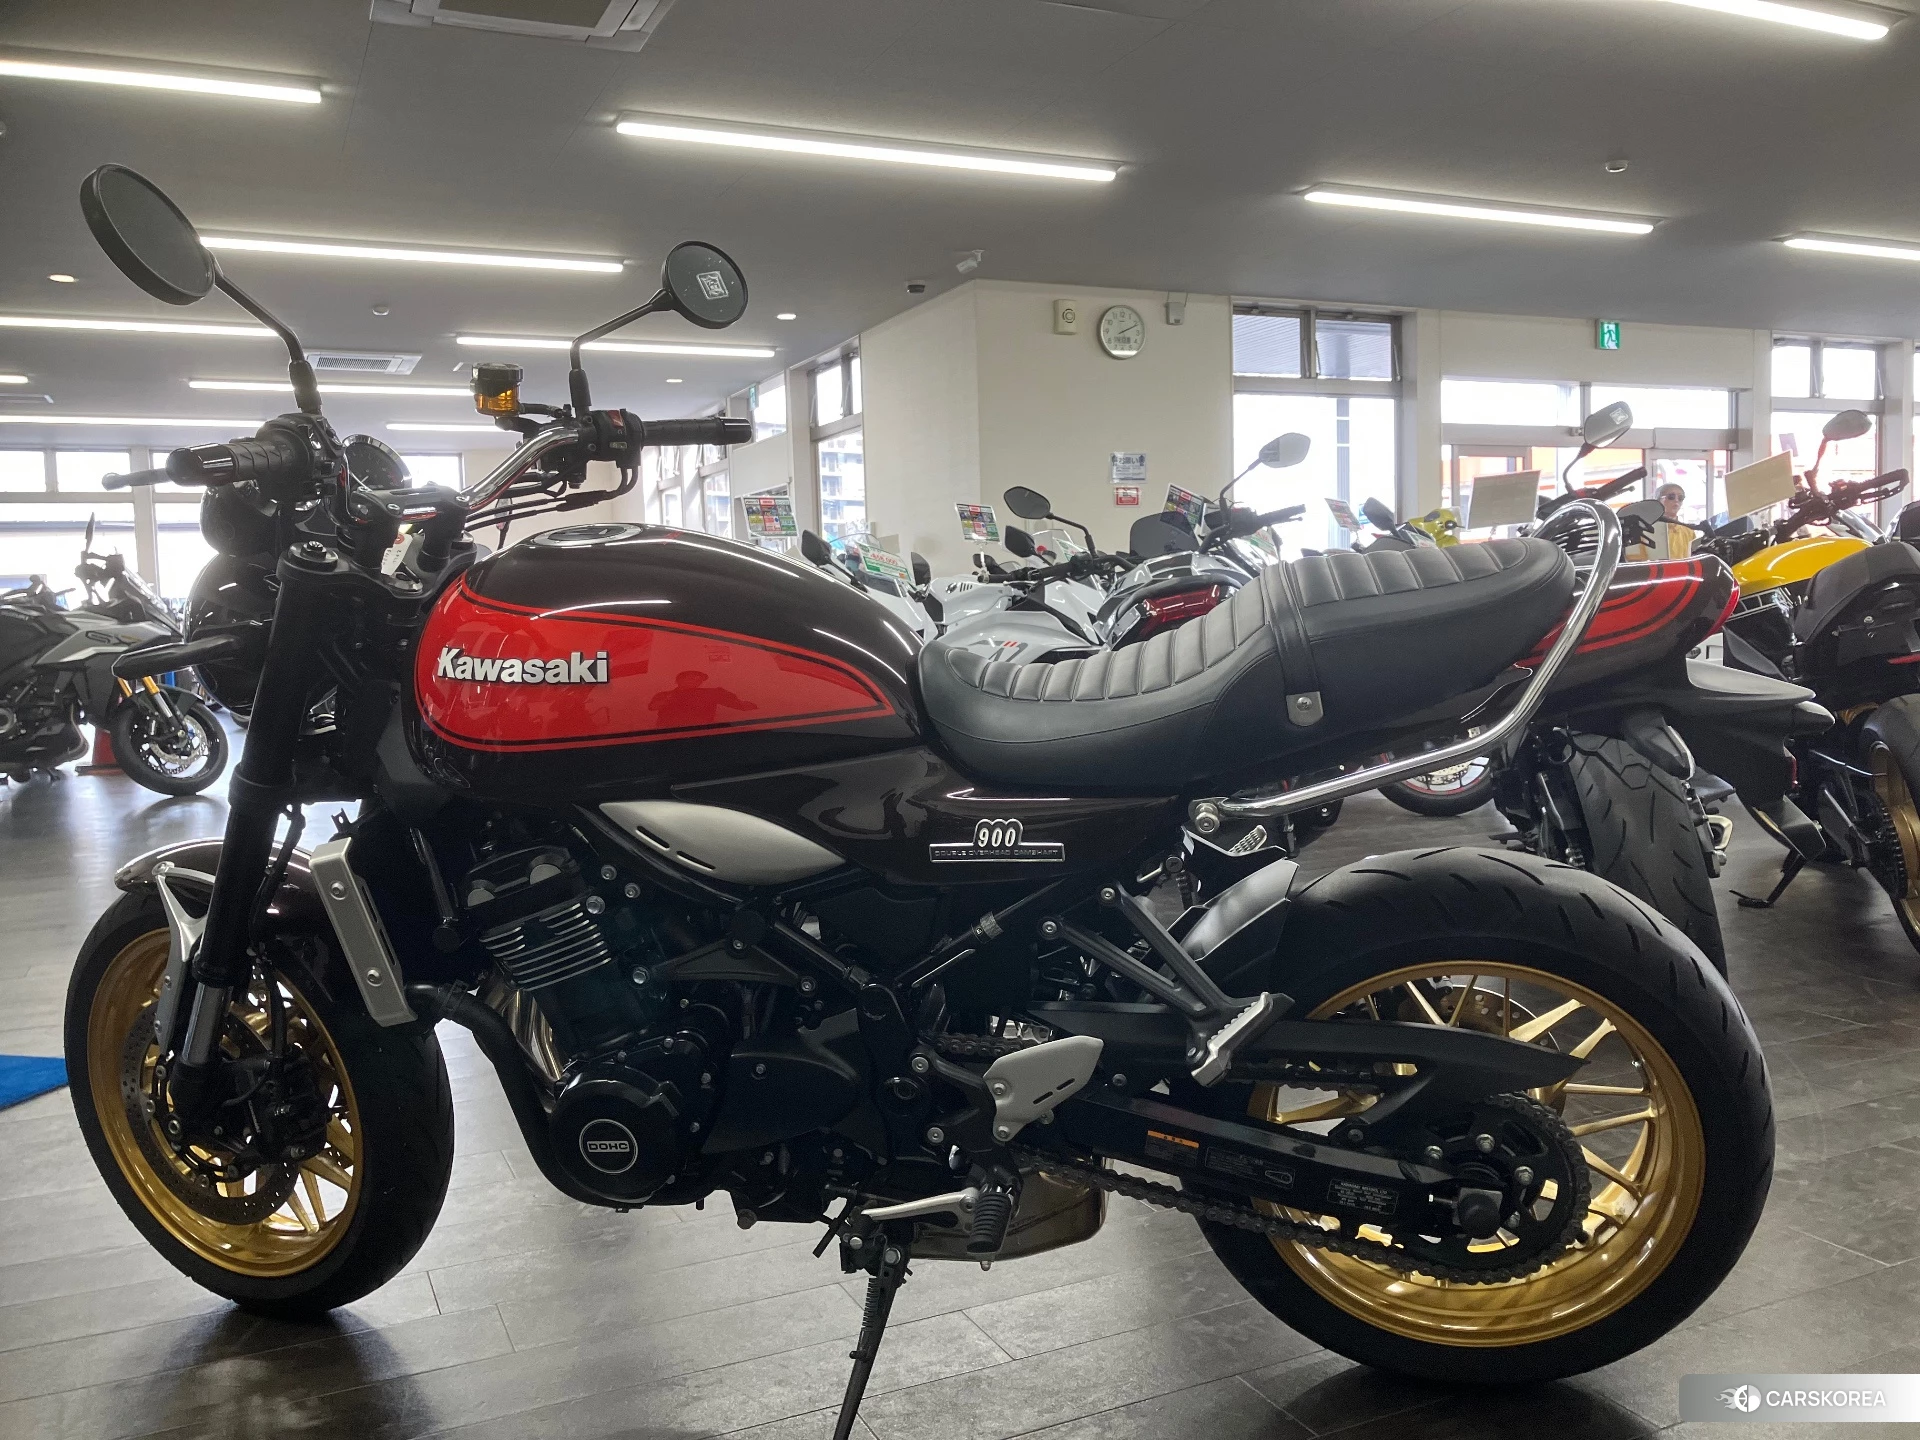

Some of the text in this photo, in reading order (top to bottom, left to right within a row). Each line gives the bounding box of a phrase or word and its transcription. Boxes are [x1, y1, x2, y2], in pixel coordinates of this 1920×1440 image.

[437, 647, 609, 684] Kawasaki
[978, 827, 1017, 848] 900
[934, 849, 967, 857] DOUBLE
[588, 1142, 629, 1151] DOHC
